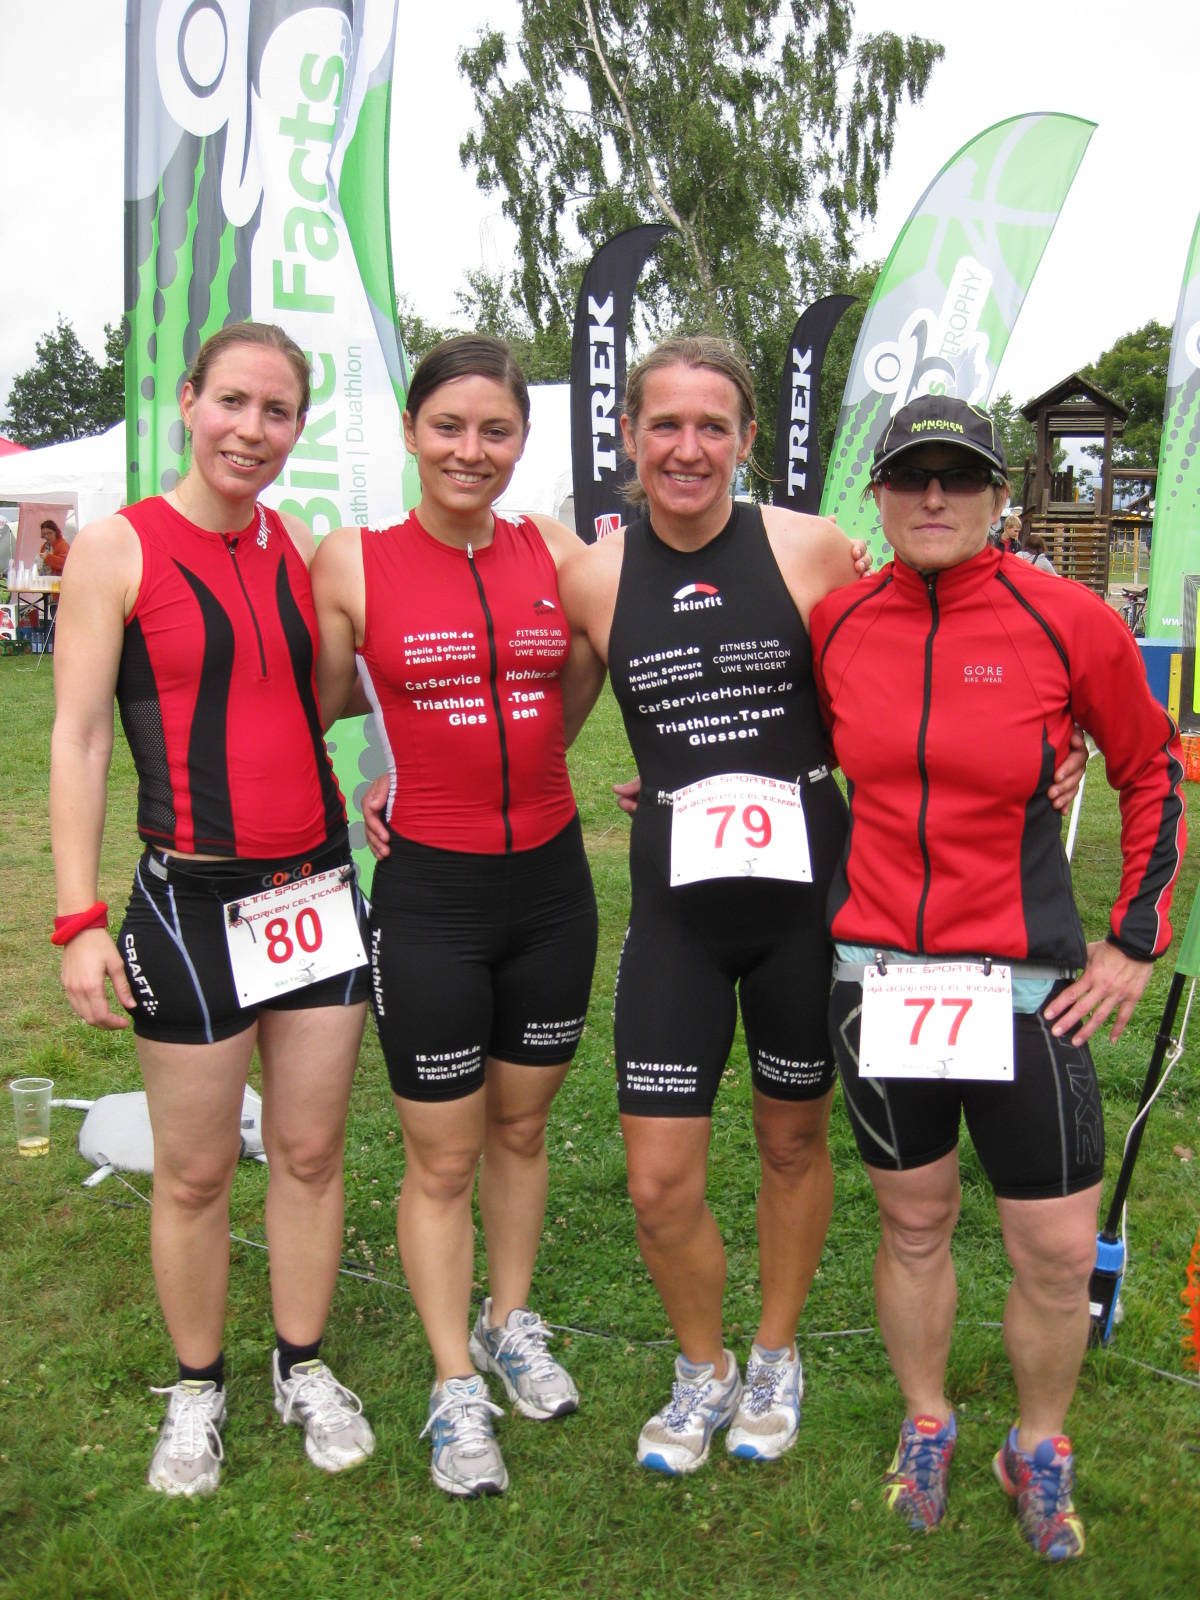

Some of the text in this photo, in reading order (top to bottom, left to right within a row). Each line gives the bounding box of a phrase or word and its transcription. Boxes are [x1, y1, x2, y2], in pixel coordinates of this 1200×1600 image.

[272, 52, 345, 314] Facts
[938, 268, 982, 356] TROPHY
[344, 345, 364, 443] Duathlon
[588, 295, 617, 482] TREK
[788, 348, 812, 497] TREK
[673, 596, 723, 613] skinfit
[404, 631, 474, 644] IS-VISION.de
[516, 629, 562, 637] FITNESS UND
[404, 644, 476, 657] Mobile Software
[509, 639, 567, 648] COMMUNICATION
[719, 639, 780, 652] FITNESS UND
[413, 655, 443, 665] Mobile
[445, 652, 476, 662] People
[515, 649, 564, 657] UWE WEIGERT
[629, 646, 700, 668] IS-VISION.de
[712, 649, 791, 664] COMMUNICATION
[629, 661, 702, 684] Mobile Software
[721, 661, 787, 674] UWE WEIGERT
[964, 665, 1003, 676] GORE
[405, 674, 481, 691] CarService
[631, 671, 703, 693] 4 Mobile People
[413, 697, 485, 711] Triathlon
[638, 682, 793, 714] CarServiceHohler.de
[449, 707, 538, 726] Gies sen
[656, 706, 785, 735] Triathlon-Team
[689, 727, 759, 746] Giessen
[675, 779, 716, 799] CELTIC
[720, 775, 777, 788] SPORTS
[706, 804, 772, 849] 79
[274, 874, 326, 897] SPORTS
[264, 907, 323, 964] 80
[125, 933, 155, 998] CRAFT
[371, 928, 385, 1016] Triathlon
[868, 966, 917, 975] CLTIC
[922, 965, 984, 974] SPORTS
[904, 998, 973, 1046] 77
[415, 1045, 480, 1062] IS-VISION.de
[758, 1049, 825, 1069] IS-VISION.de
[626, 1061, 698, 1073] IS-VISION.de
[783, 1071, 823, 1079] Software
[427, 1072, 457, 1080] Mobile
[626, 1074, 697, 1085] Mobile Software
[762, 1070, 787, 1083] Mobile
[790, 1077, 821, 1085] People
[633, 1083, 664, 1092] Mobile
[666, 1085, 696, 1094] People
